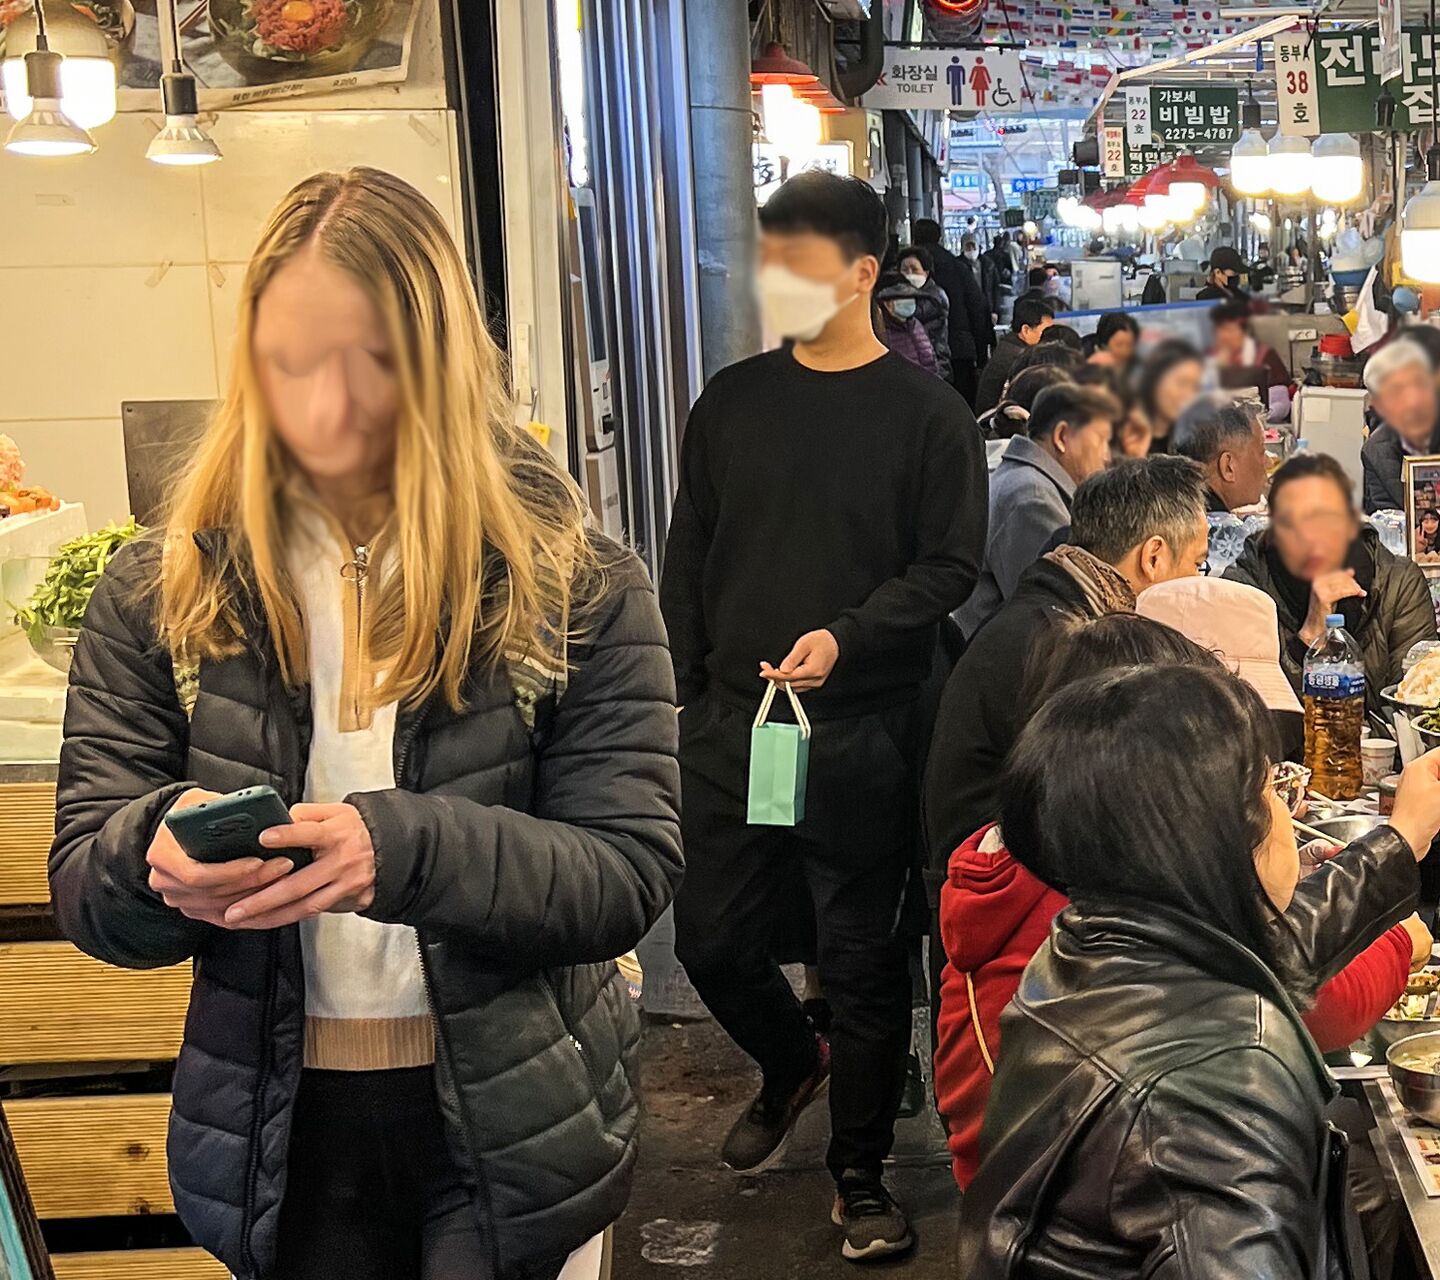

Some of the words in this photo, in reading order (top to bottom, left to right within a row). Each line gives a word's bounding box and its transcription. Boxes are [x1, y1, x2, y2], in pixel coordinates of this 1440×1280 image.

[891, 64, 938, 82] 화장실
[896, 83, 936, 94] TOILET
[1286, 70, 1308, 94] 38
[1159, 91, 1197, 104] 가보세
[1131, 109, 1147, 120] 22
[1159, 105, 1231, 125] 비빔밥
[1293, 103, 1309, 123] 호
[1165, 128, 1234, 140] 2275-4787
[1107, 150, 1121, 161] 22
